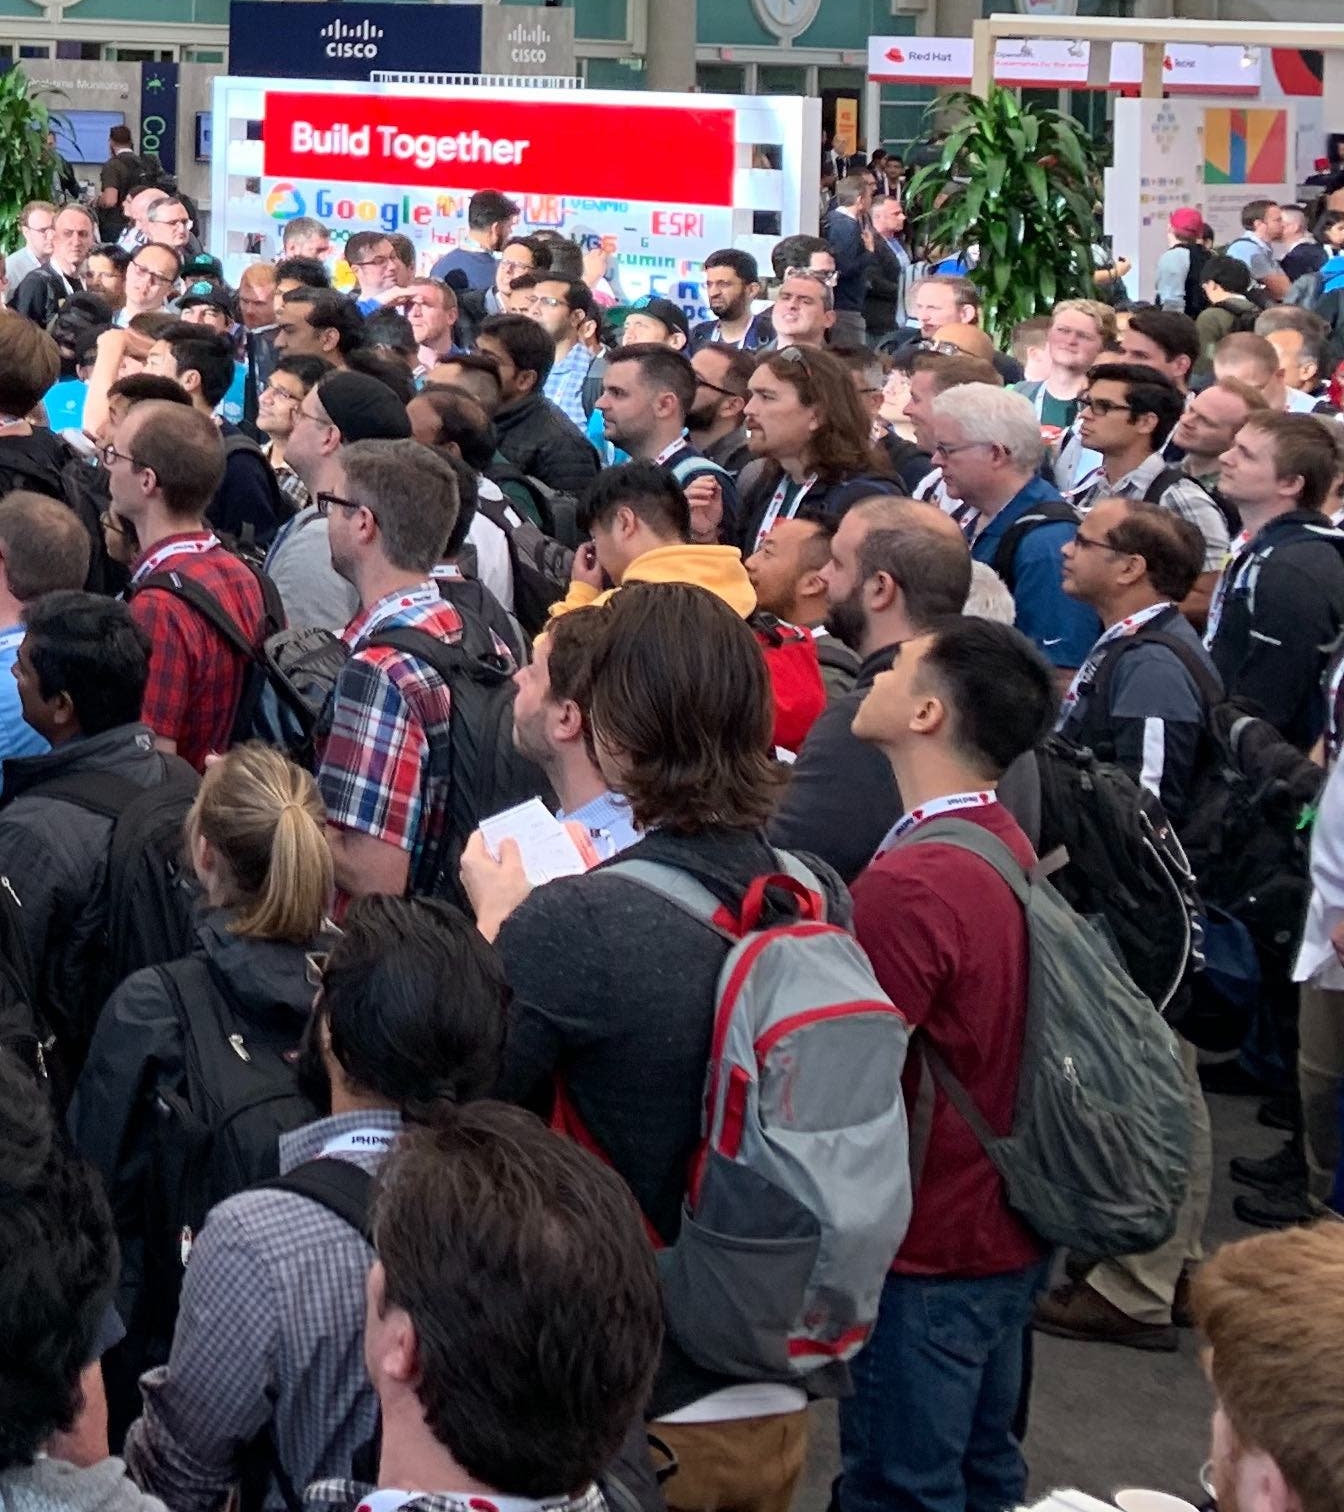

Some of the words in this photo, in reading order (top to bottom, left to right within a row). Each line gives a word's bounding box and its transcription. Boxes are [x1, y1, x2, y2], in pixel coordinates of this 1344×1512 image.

[326, 43, 377, 58] CISCO
[512, 49, 546, 63] CISCO
[909, 52, 930, 61] Red
[932, 52, 952, 62] Hat
[291, 121, 370, 156] Build
[376, 125, 530, 169] Together
[316, 189, 432, 232] Google
[652, 210, 704, 238] ESRI
[352, 1136, 370, 1145] Hat
